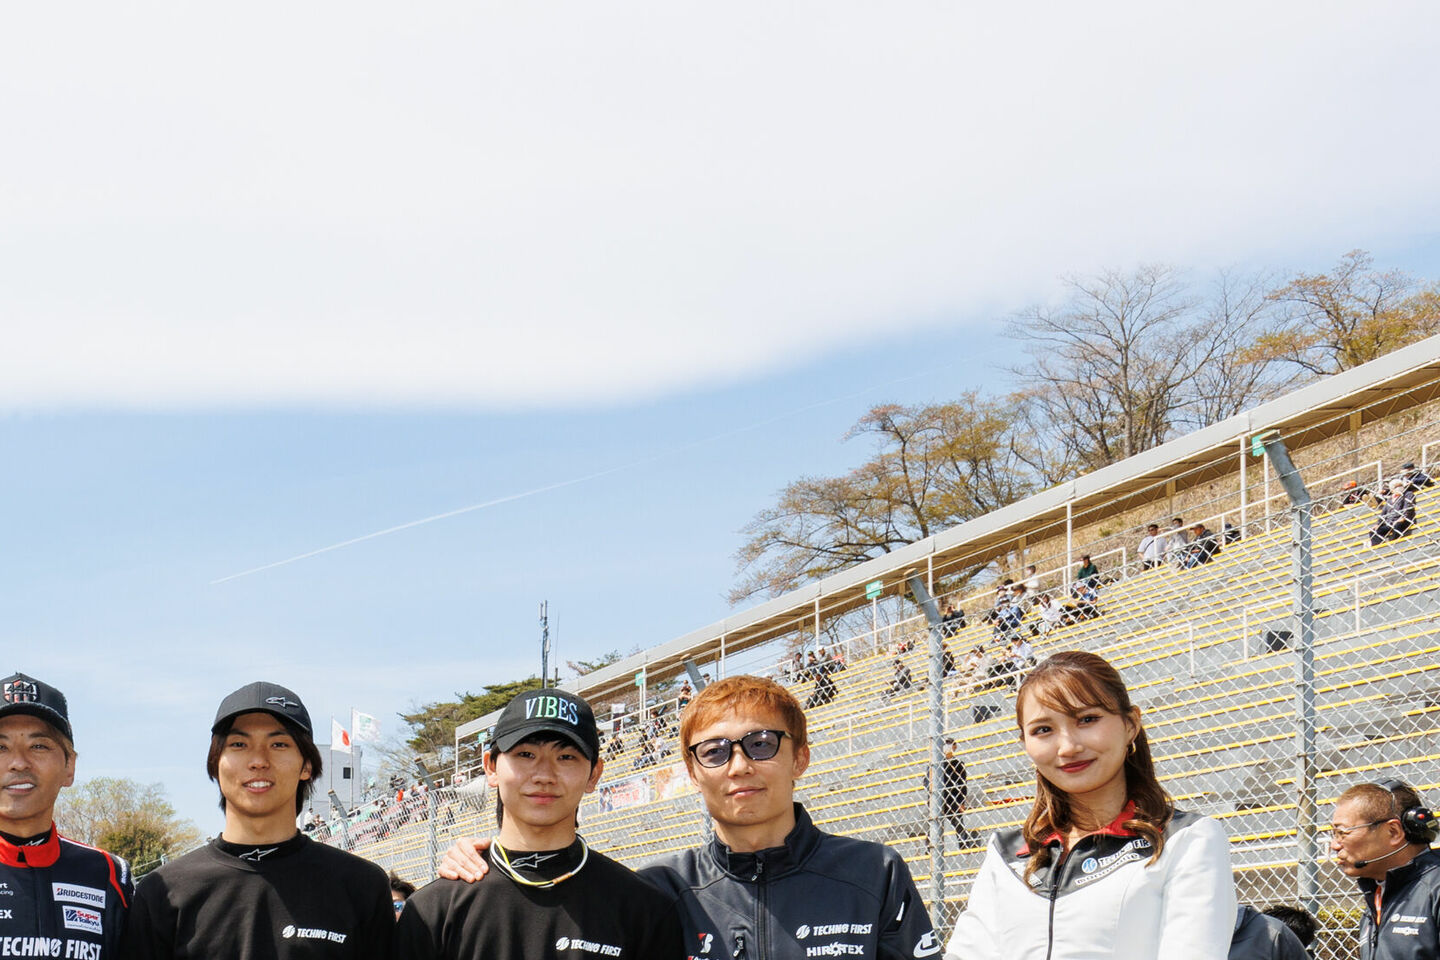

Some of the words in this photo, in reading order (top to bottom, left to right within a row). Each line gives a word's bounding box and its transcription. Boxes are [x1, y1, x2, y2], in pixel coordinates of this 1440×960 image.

[525, 696, 578, 725] VIBES
[56, 887, 104, 904] BRIDGESTONE
[850, 923, 873, 935] FIRST
[328, 931, 347, 944] FIRST
[600, 944, 622, 957] FIRST
